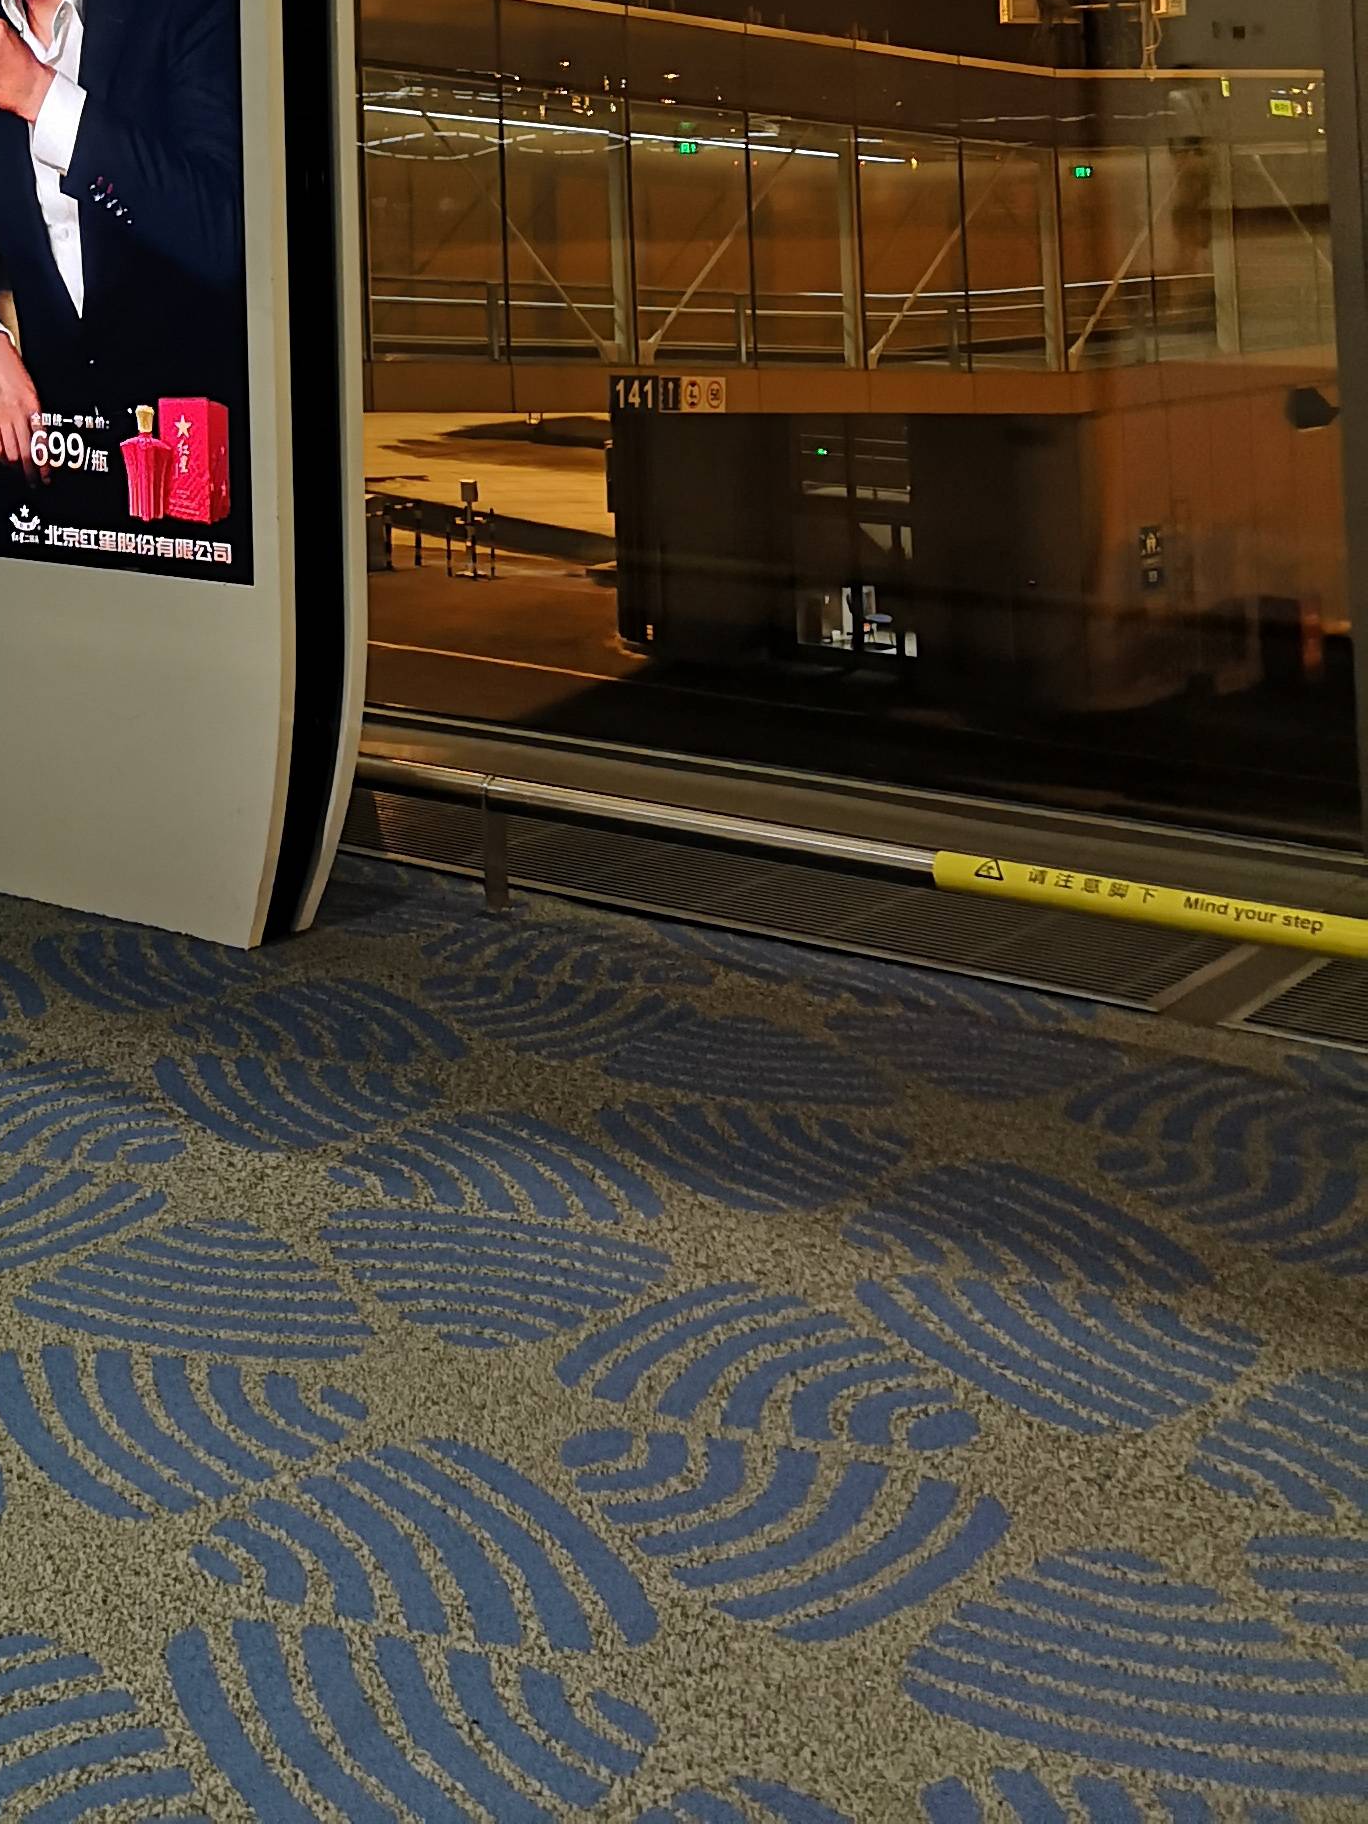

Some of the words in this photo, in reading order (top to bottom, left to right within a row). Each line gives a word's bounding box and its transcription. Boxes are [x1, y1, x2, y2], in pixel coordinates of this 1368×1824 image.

[615, 378, 653, 409] 141
[31, 430, 110, 473] 699/瓶
[44, 524, 232, 564] 北京红星股份有限公司
[1028, 867, 1159, 905] 请注意脚下
[1183, 895, 1229, 917] Mind
[1233, 905, 1277, 924] your
[1282, 913, 1325, 935] step
